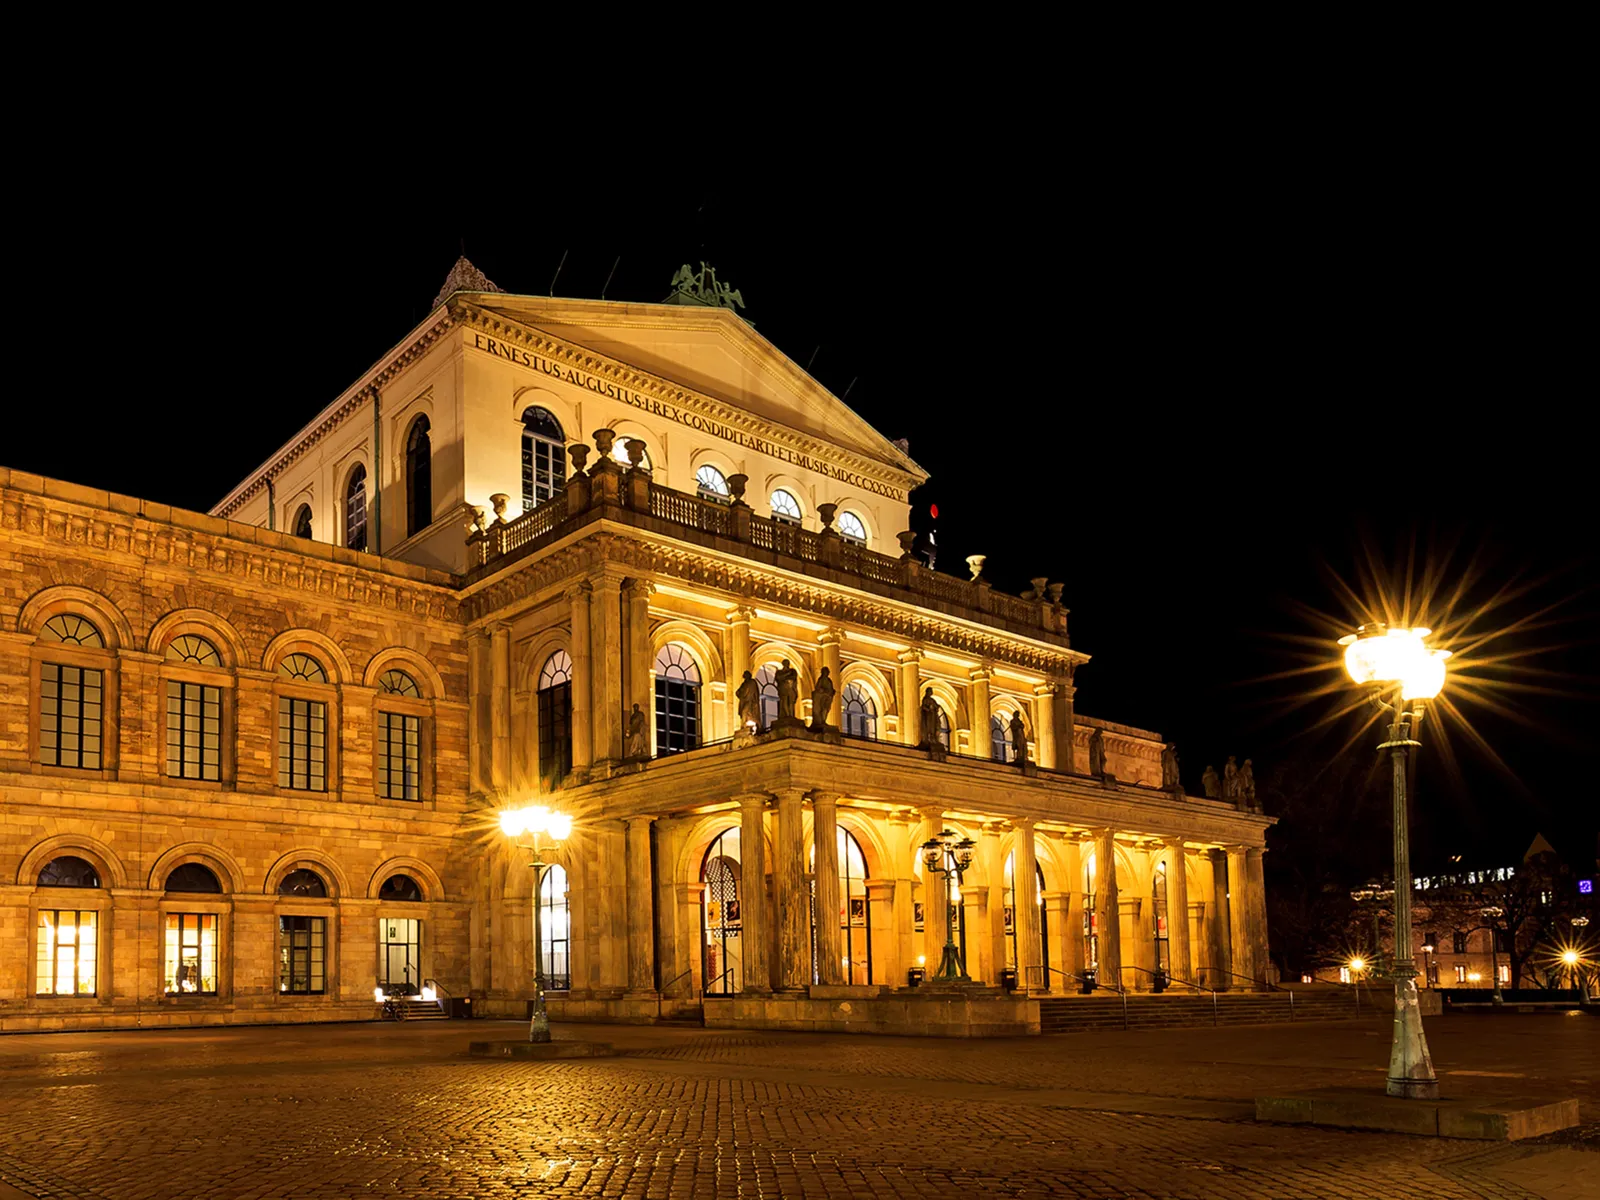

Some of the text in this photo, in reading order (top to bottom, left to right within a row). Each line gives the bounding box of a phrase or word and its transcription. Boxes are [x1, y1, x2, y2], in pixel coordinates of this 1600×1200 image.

[475, 333, 561, 378] ERNESTUS
[564, 371, 641, 408] AUGUSTUS
[653, 403, 680, 421] REX
[683, 409, 745, 446] CONDIDIT
[748, 436, 775, 456] ARTI
[778, 447, 794, 462] ET
[796, 453, 829, 475] MUSIS
